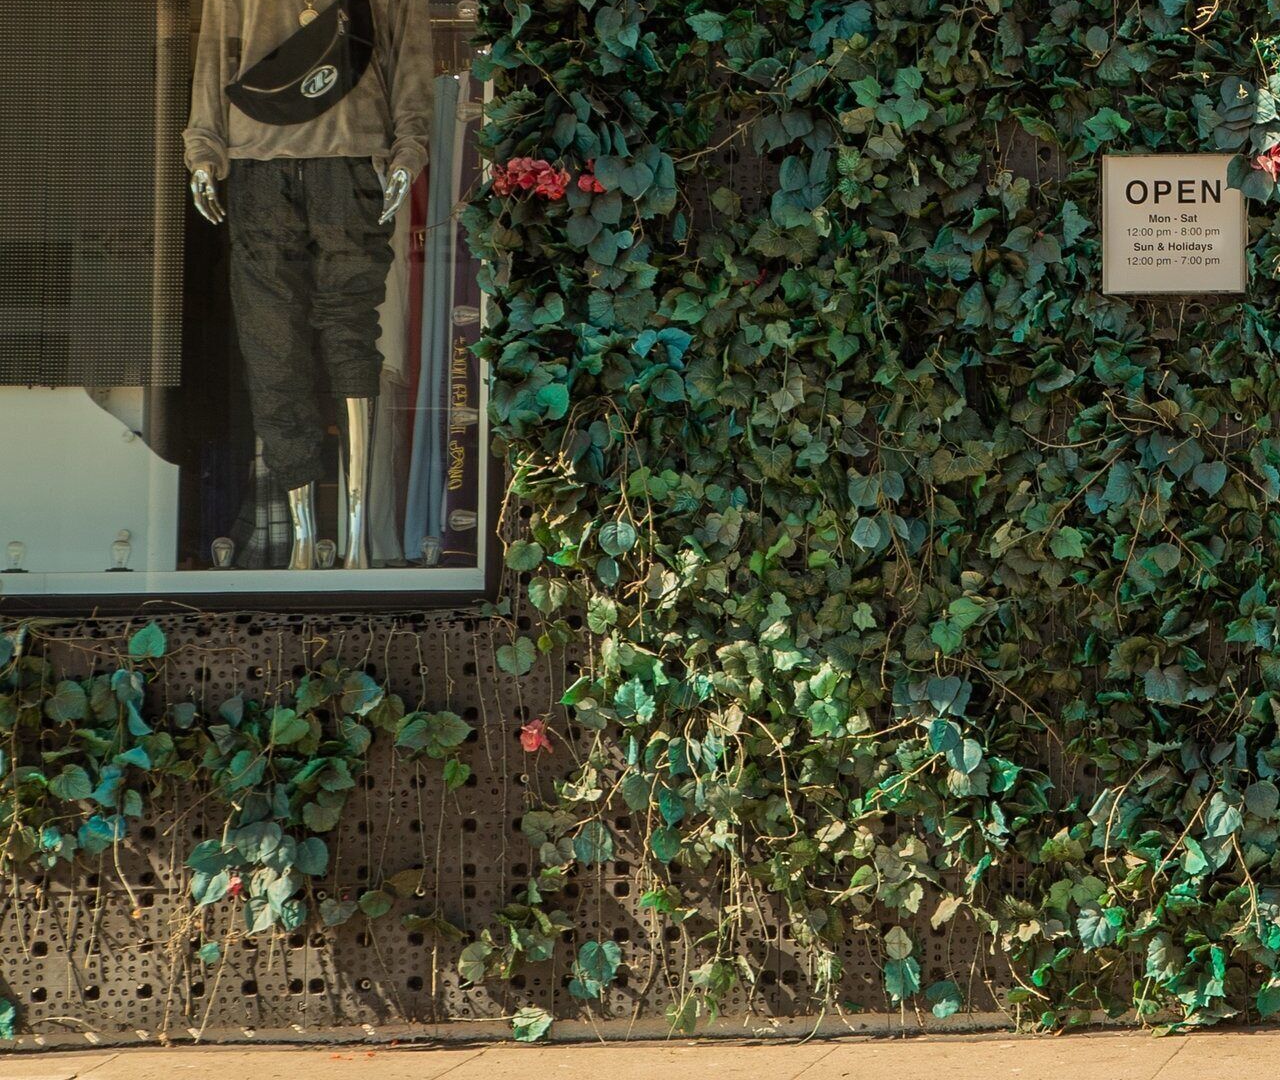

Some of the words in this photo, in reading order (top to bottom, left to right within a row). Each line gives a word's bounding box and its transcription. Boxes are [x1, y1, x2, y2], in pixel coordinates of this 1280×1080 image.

[1125, 179, 1221, 205] OPEN
[1148, 214, 1171, 223] Mon
[1180, 213, 1198, 223] Sat
[1126, 227, 1153, 237] 12:00
[1156, 229, 1171, 238] pm
[1180, 227, 1202, 236] 8:00
[1204, 229, 1220, 238] pm
[1133, 242, 1154, 251] Sun
[1157, 242, 1165, 251] &
[1168, 242, 1213, 253] Holidays
[1126, 257, 1153, 266] 12:00
[1156, 258, 1171, 267] pm
[1180, 256, 1202, 265] 7:00
[1204, 258, 1220, 267] pm
